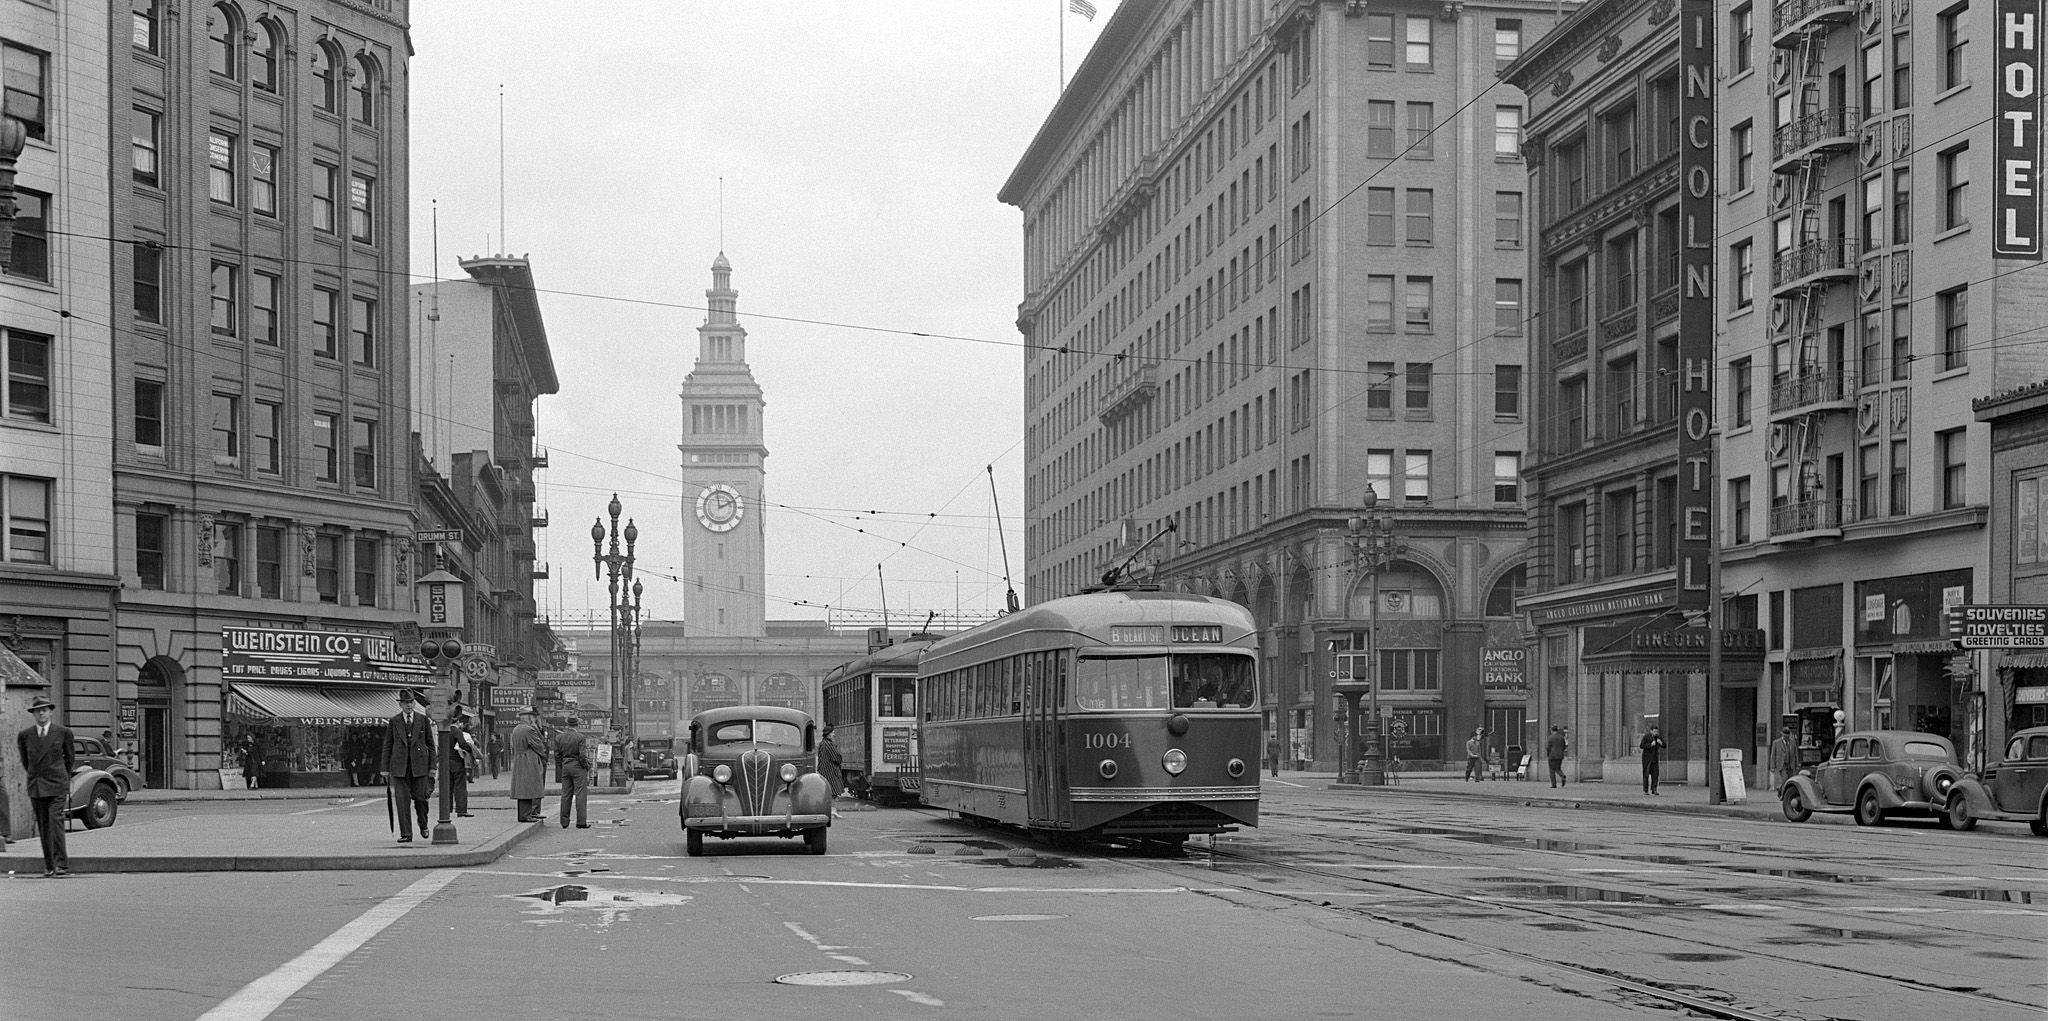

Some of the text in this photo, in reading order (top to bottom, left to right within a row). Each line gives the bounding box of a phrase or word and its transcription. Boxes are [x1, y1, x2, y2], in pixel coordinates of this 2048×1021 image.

[2004, 12, 2034, 246] HOTEL
[1684, 15, 1710, 590] INCOLN HOTEL
[418, 533, 446, 541] DRUMM
[432, 585, 445, 622] STOP
[1546, 593, 1664, 619] ANGLO CALIFORNIA NATIONAL BANK
[1966, 608, 2046, 620] SOUVENIRS
[1112, 629, 1120, 642] B
[1171, 627, 1221, 642] OCEAN
[1966, 623, 2045, 636] NOVELTIES
[232, 631, 321, 653] WEINSTEIN
[875, 630, 883, 643] 1
[1637, 631, 1762, 648] LINCOLN OTEL
[1966, 637, 2046, 646] GREETING CARDS
[1484, 650, 1524, 661] ANGLO
[1485, 672, 1523, 683] BANK
[301, 717, 390, 726] WEINSTEIN
[1084, 732, 1132, 749] 1004
